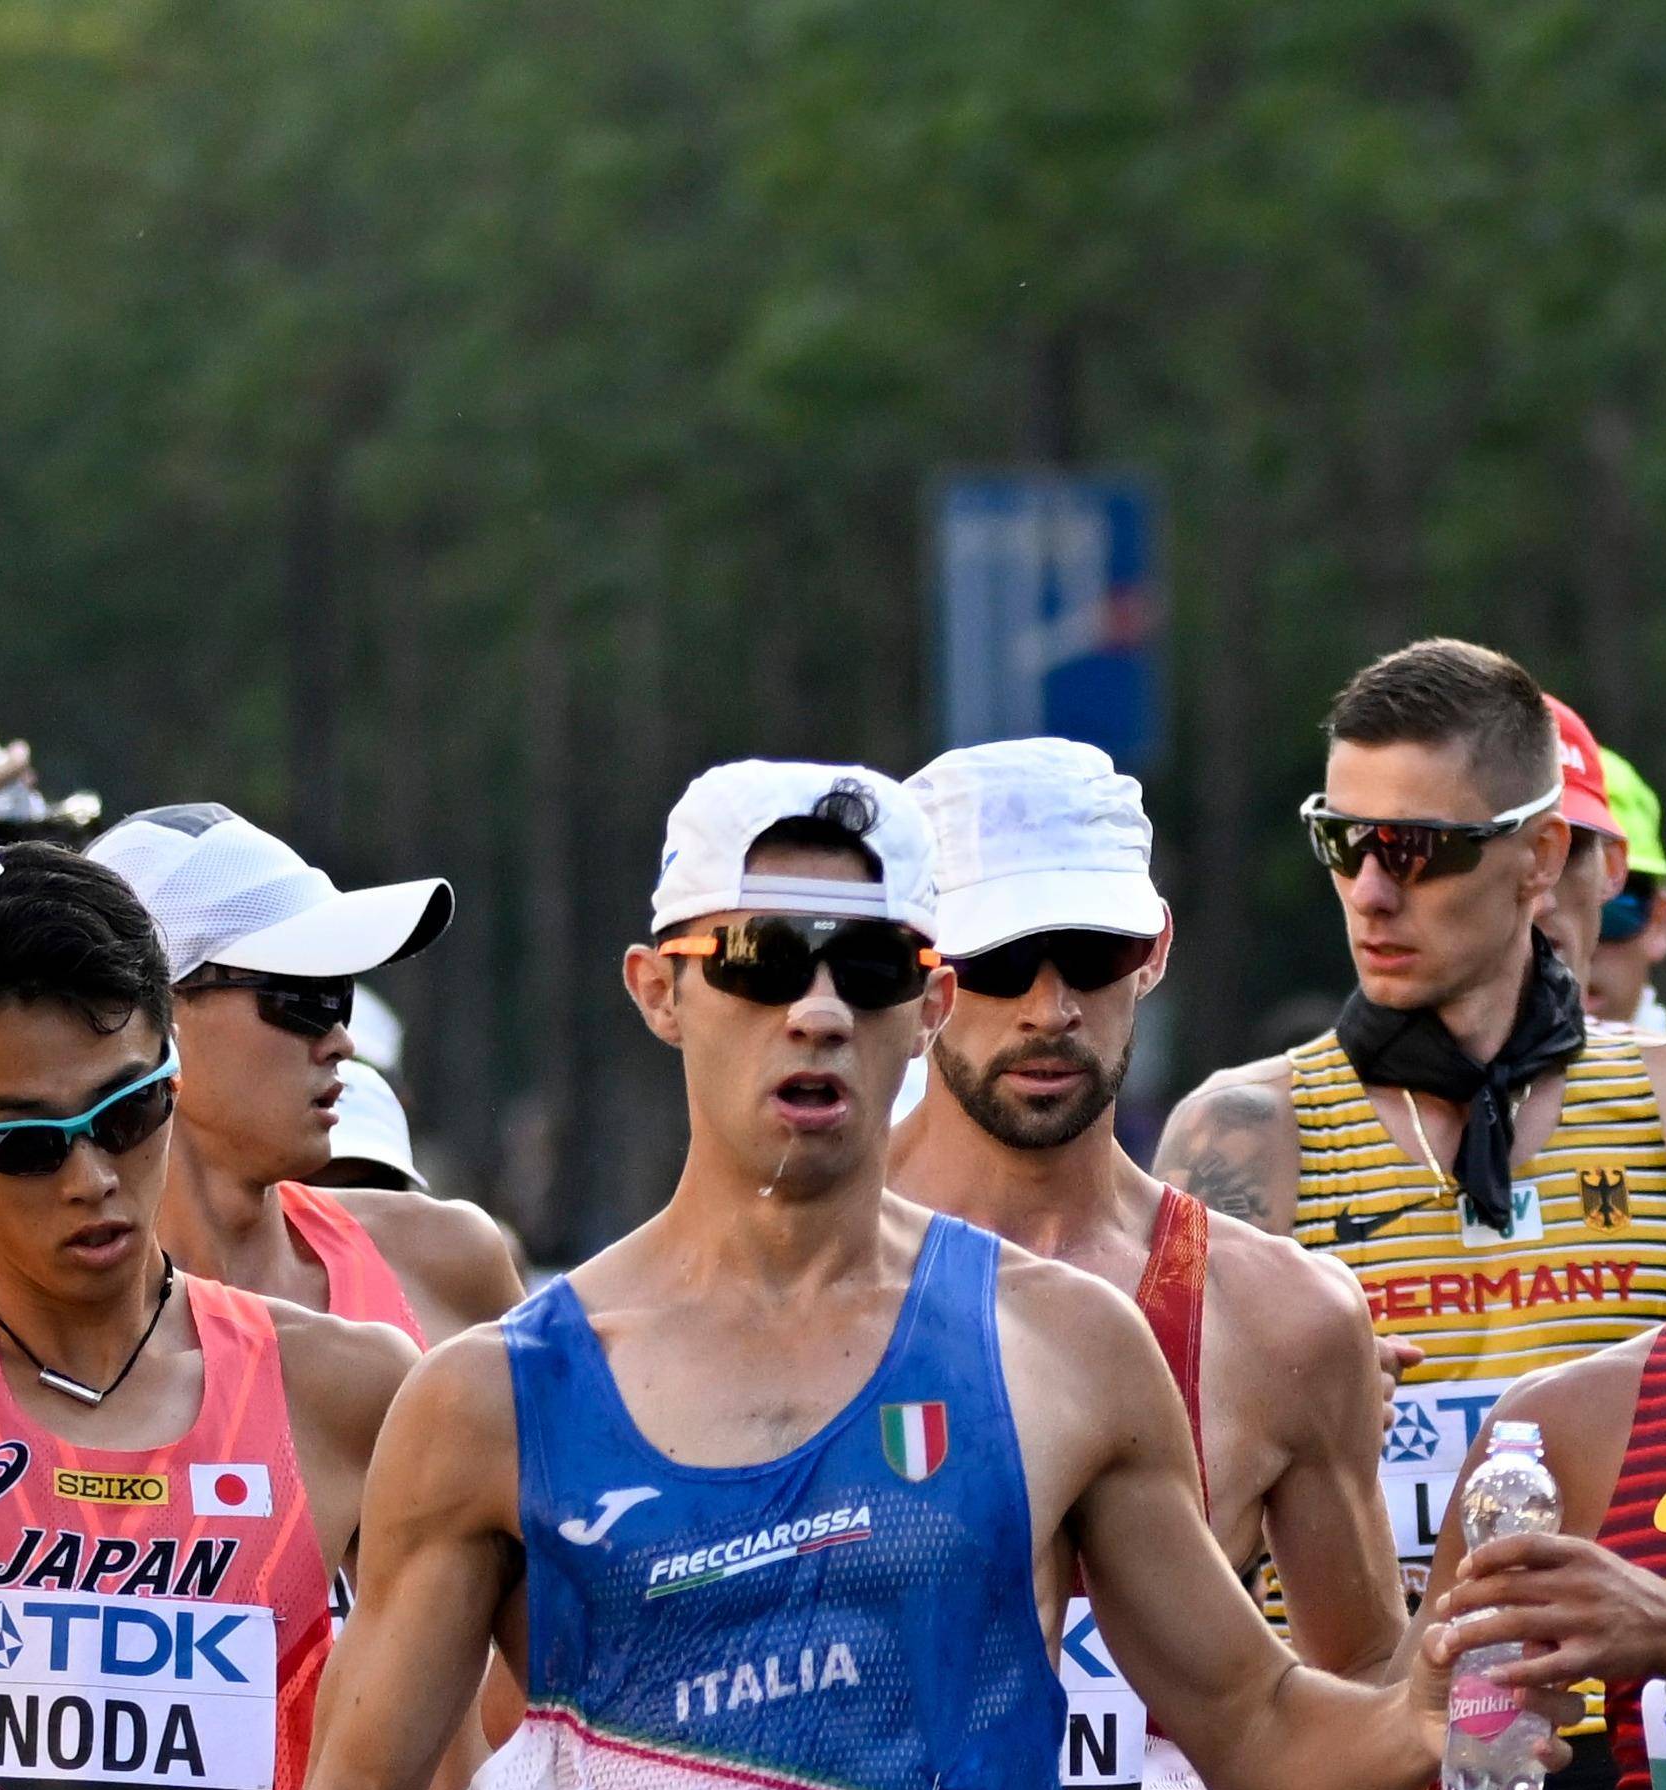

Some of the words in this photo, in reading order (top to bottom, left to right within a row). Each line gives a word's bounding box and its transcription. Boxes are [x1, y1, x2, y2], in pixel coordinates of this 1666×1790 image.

[57, 1473, 164, 1500] SEIKO
[650, 1506, 872, 1585] FRECCIAROSSA
[23, 1601, 251, 1684] TDK
[674, 1643, 862, 1723] ITALIA
